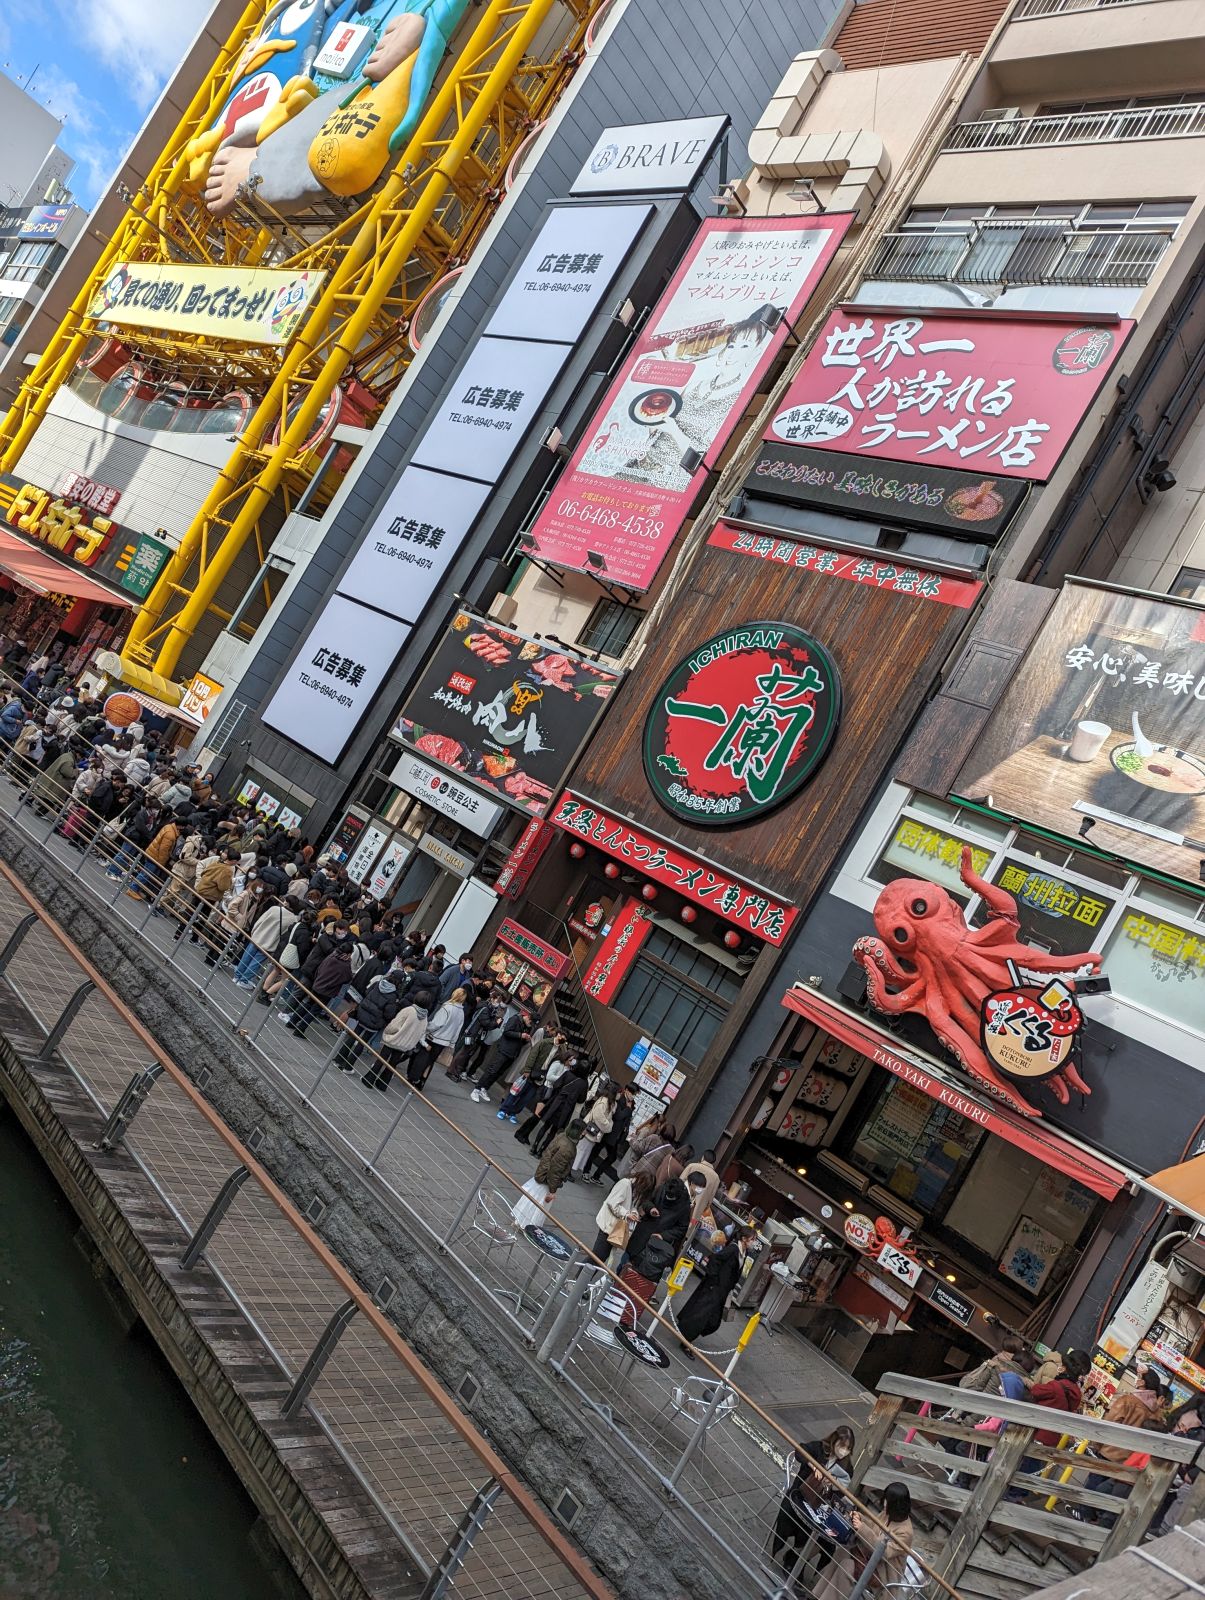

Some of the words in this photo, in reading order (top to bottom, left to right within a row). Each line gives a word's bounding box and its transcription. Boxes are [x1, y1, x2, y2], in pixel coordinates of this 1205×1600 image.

[616, 139, 706, 169] BRAVE
[536, 253, 604, 274] 広告募集
[705, 252, 803, 269] マダムシンコ
[522, 281, 592, 293] TEL:06-6940-4974
[688, 283, 785, 301] マダムブリュレ
[695, 271, 793, 282] マダムシンコといえば、
[822, 317, 976, 371] 世界一
[1057, 332, 1111, 368] 一蘭
[461, 385, 525, 412] 広告募集
[826, 368, 1016, 416] 人が訪れる
[448, 412, 513, 432] TEL:06-6940-4974
[775, 404, 851, 432] 一蘭全店舗中
[786, 423, 828, 441] 世界一
[855, 412, 1051, 469] ラーメン店
[387, 515, 446, 550] 広告募集
[557, 499, 664, 540] 06-6468-4538
[374, 541, 433, 570] TEL:06-6940-4974
[311, 647, 368, 688] 広告募集
[688, 630, 783, 675] ICHIRAN
[298, 671, 354, 709] TEL:06-6940-4974
[429, 686, 473, 715] 和牛焼肉
[665, 663, 825, 804] 一蘭
[414, 786, 441, 806] COSMETIC
[441, 802, 459, 817] STORE
[667, 782, 742, 814] 昭和35年創業
[555, 800, 786, 940] 天然とんこつラーメン専門店
[998, 865, 1107, 927] 蘭州拉面
[1002, 1008, 1053, 1052] くくる
[999, 1049, 1031, 1069] KUKURU
[872, 1048, 932, 1090] TAKO-YAKI
[938, 1088, 990, 1125] KUKURU
[889, 1252, 911, 1275] くくる
